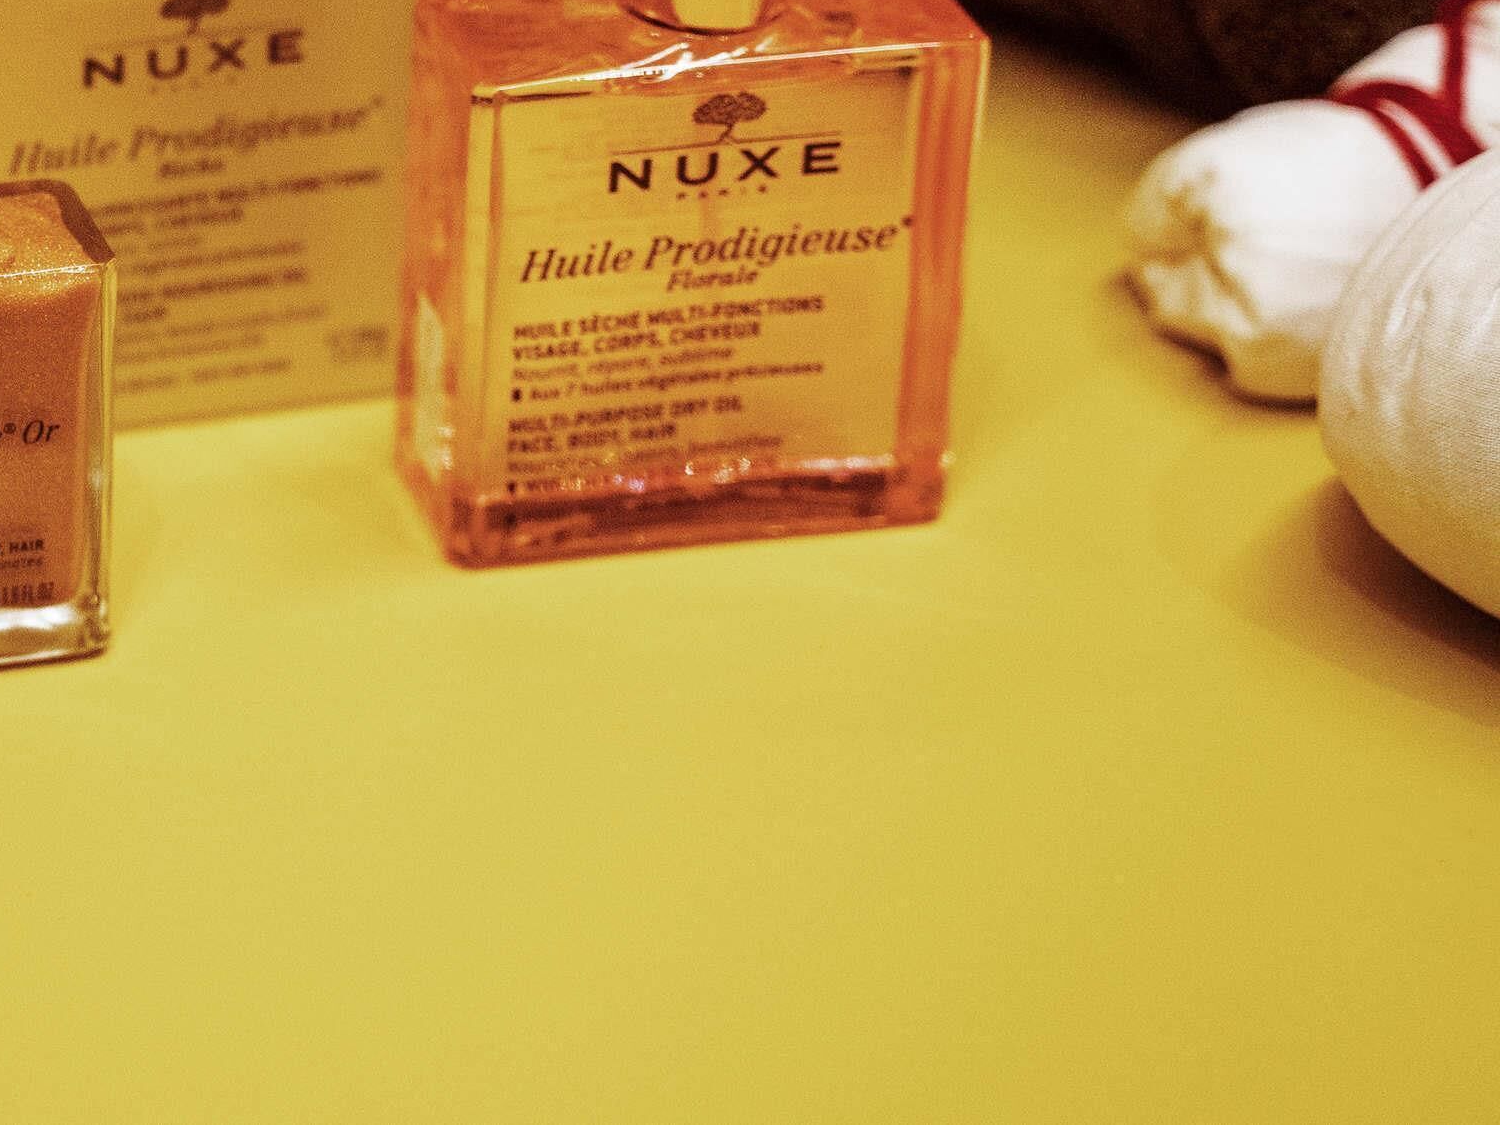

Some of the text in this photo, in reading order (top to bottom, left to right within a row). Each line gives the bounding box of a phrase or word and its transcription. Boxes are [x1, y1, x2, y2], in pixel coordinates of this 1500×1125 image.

[81, 28, 305, 90] NUXE
[8, 132, 121, 176] Huile
[607, 141, 842, 194] NUXE
[519, 239, 635, 284] Huile
[666, 264, 760, 294] Florale
[513, 295, 824, 340] HUILE SÈCHE MULTI-FONCTIONS
[512, 340, 589, 361] VISAGE,
[22, 418, 61, 446] Or
[9, 538, 45, 555] HAIR
